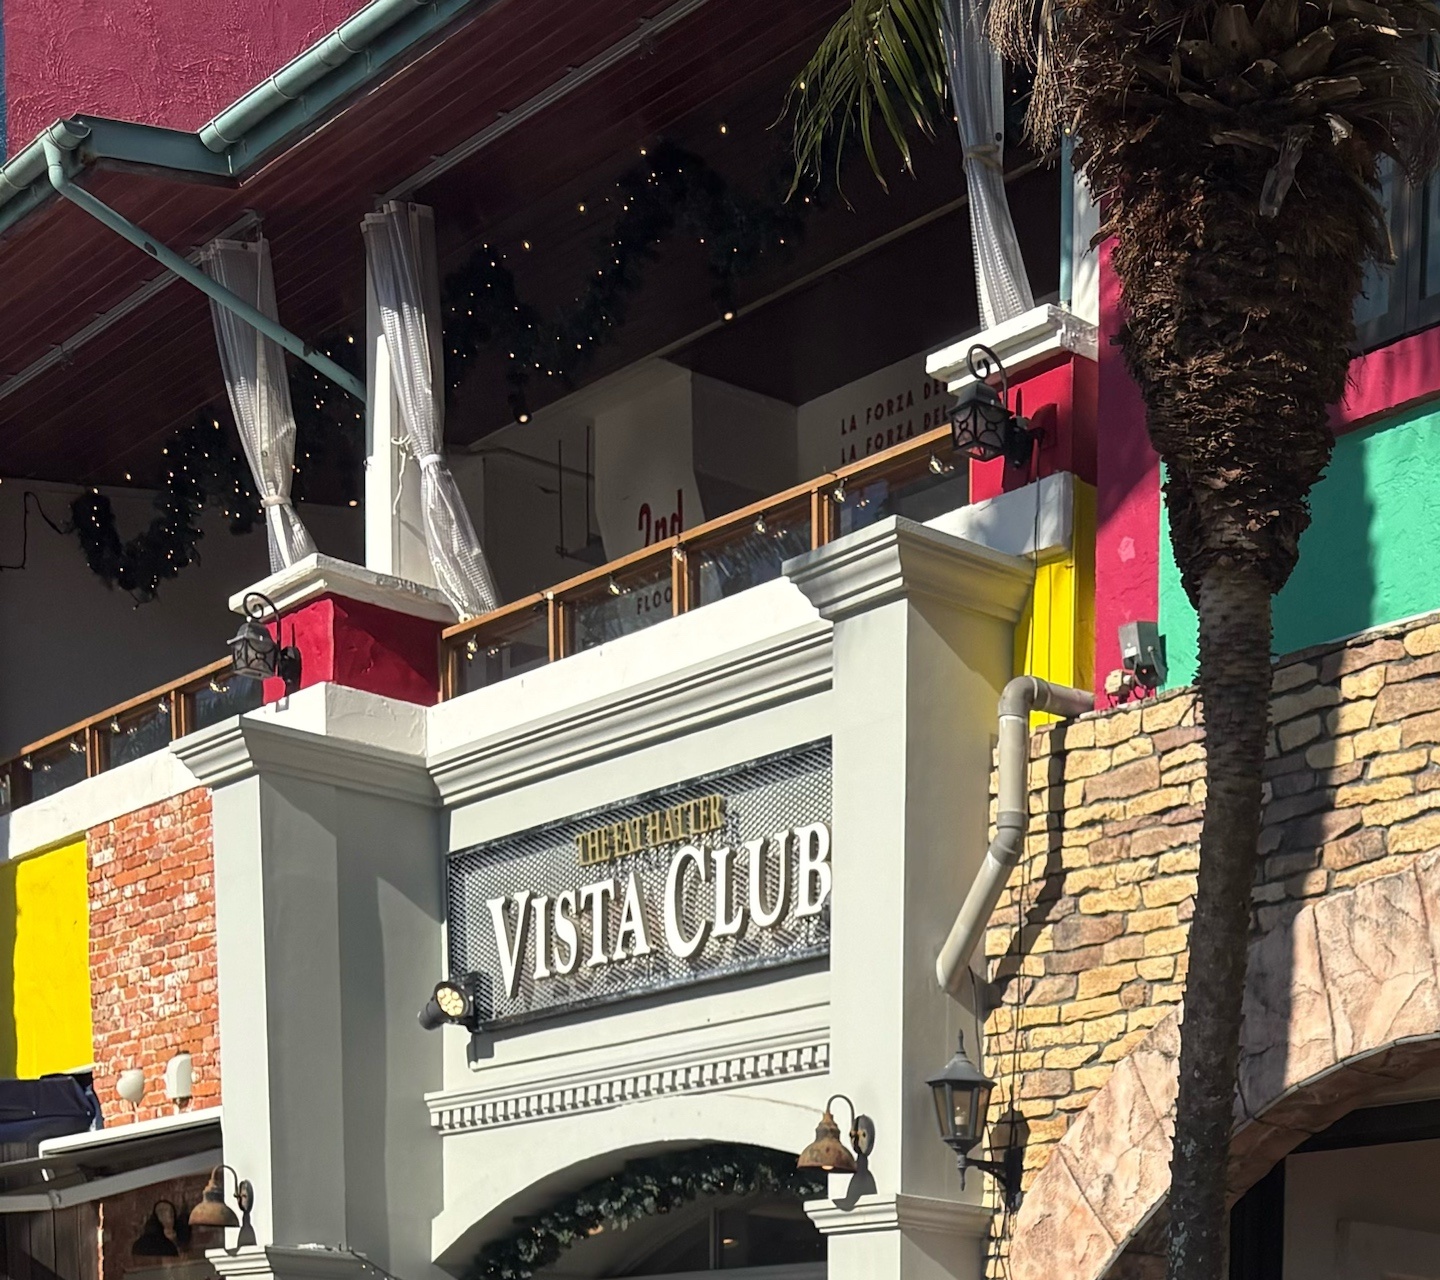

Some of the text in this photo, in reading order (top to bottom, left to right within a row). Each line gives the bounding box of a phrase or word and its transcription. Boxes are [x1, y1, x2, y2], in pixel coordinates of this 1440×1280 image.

[841, 414, 857, 436] LA
[866, 389, 914, 425] FORZA
[866, 420, 914, 455] FORZA
[637, 488, 684, 548] 2nd
[637, 586, 673, 615] FLOO
[575, 793, 726, 867] THE FAT HATTER
[486, 820, 832, 1000] VISTA CLUB
